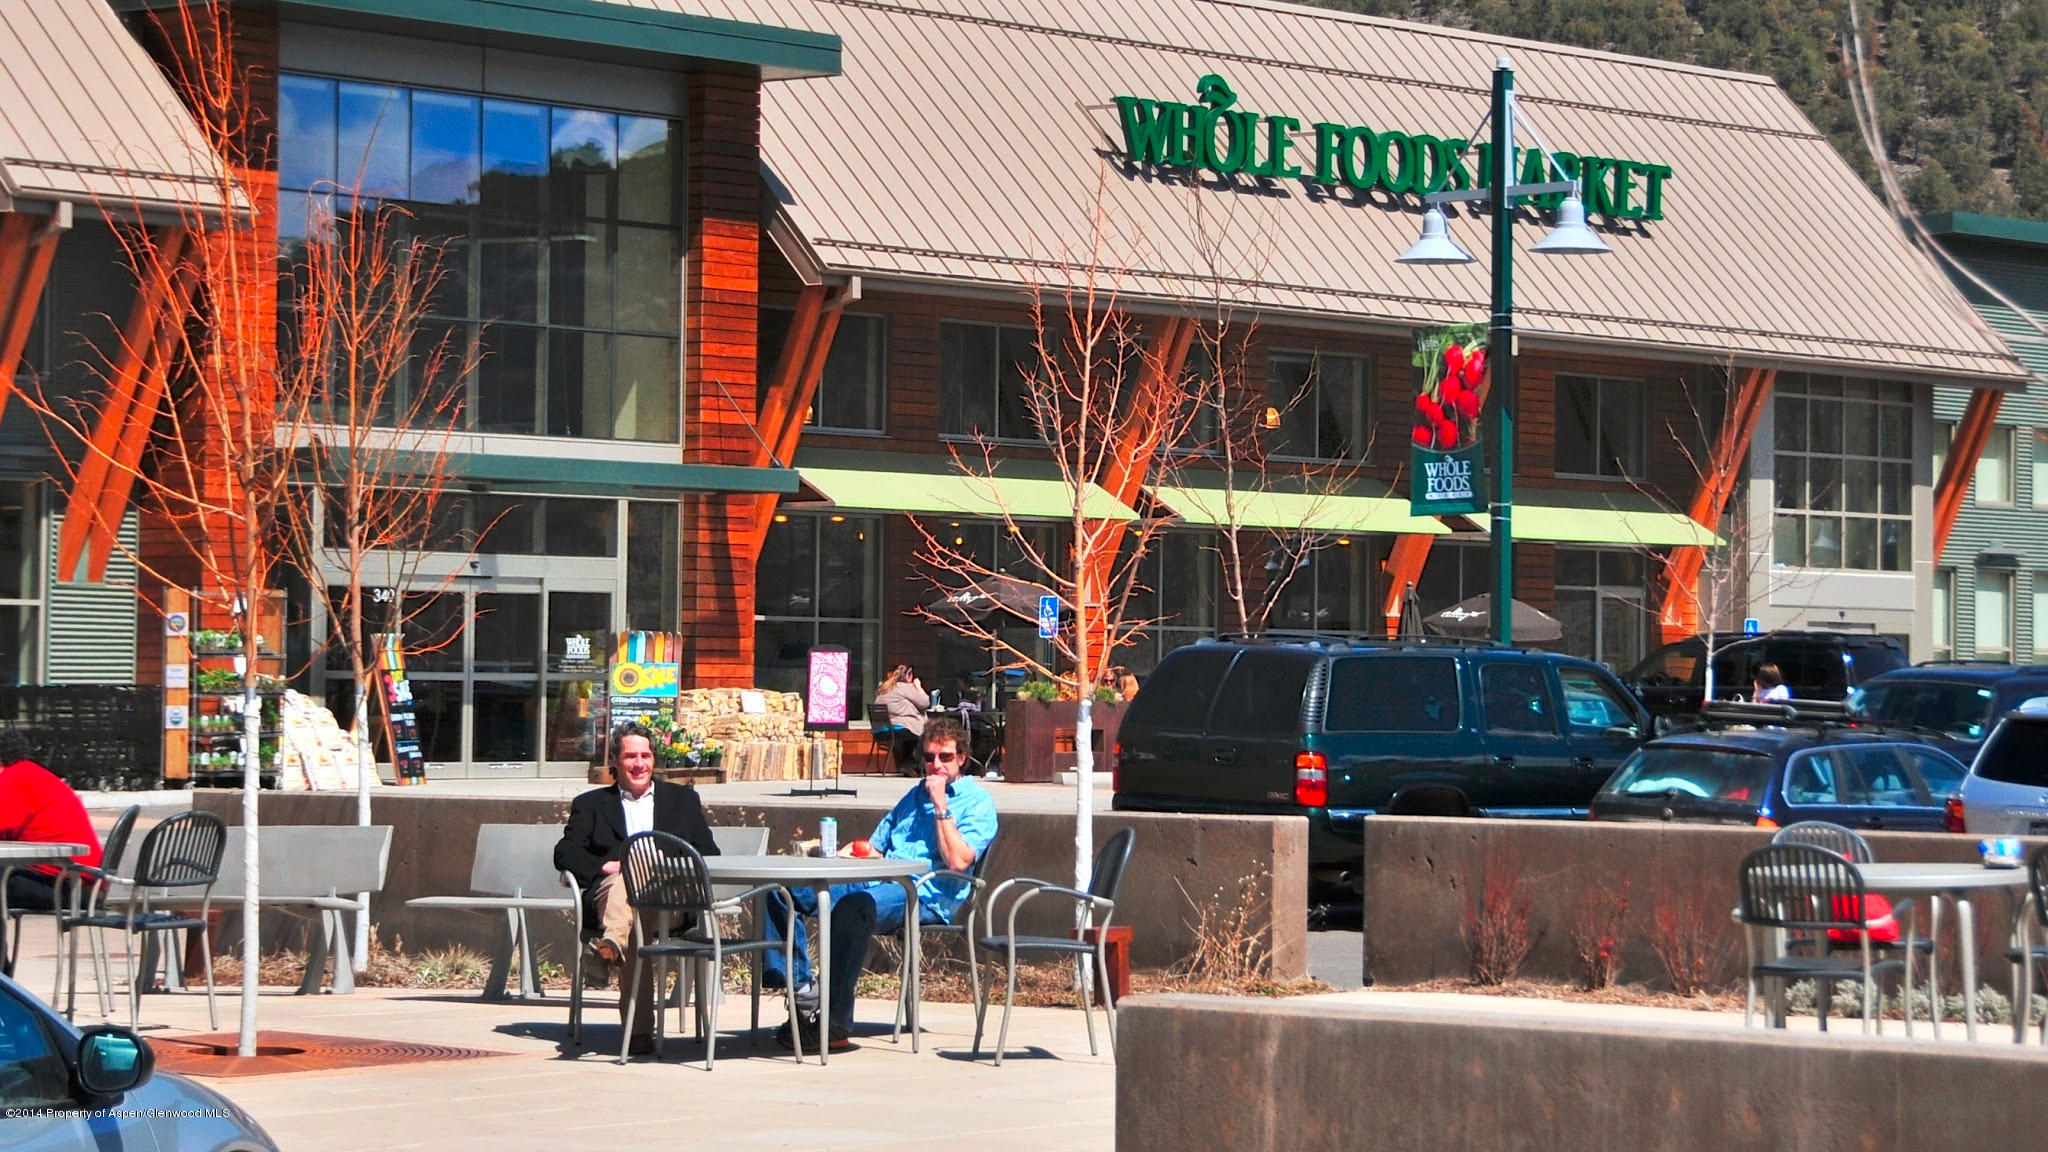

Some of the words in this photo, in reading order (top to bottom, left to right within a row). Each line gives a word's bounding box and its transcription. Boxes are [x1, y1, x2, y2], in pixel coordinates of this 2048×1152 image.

[1110, 90, 1303, 179] WHOLE
[1314, 121, 1470, 196] FOODS
[1424, 460, 1472, 477] WHOLE
[1427, 476, 1471, 492] FOODS
[565, 637, 591, 647] WHOLE
